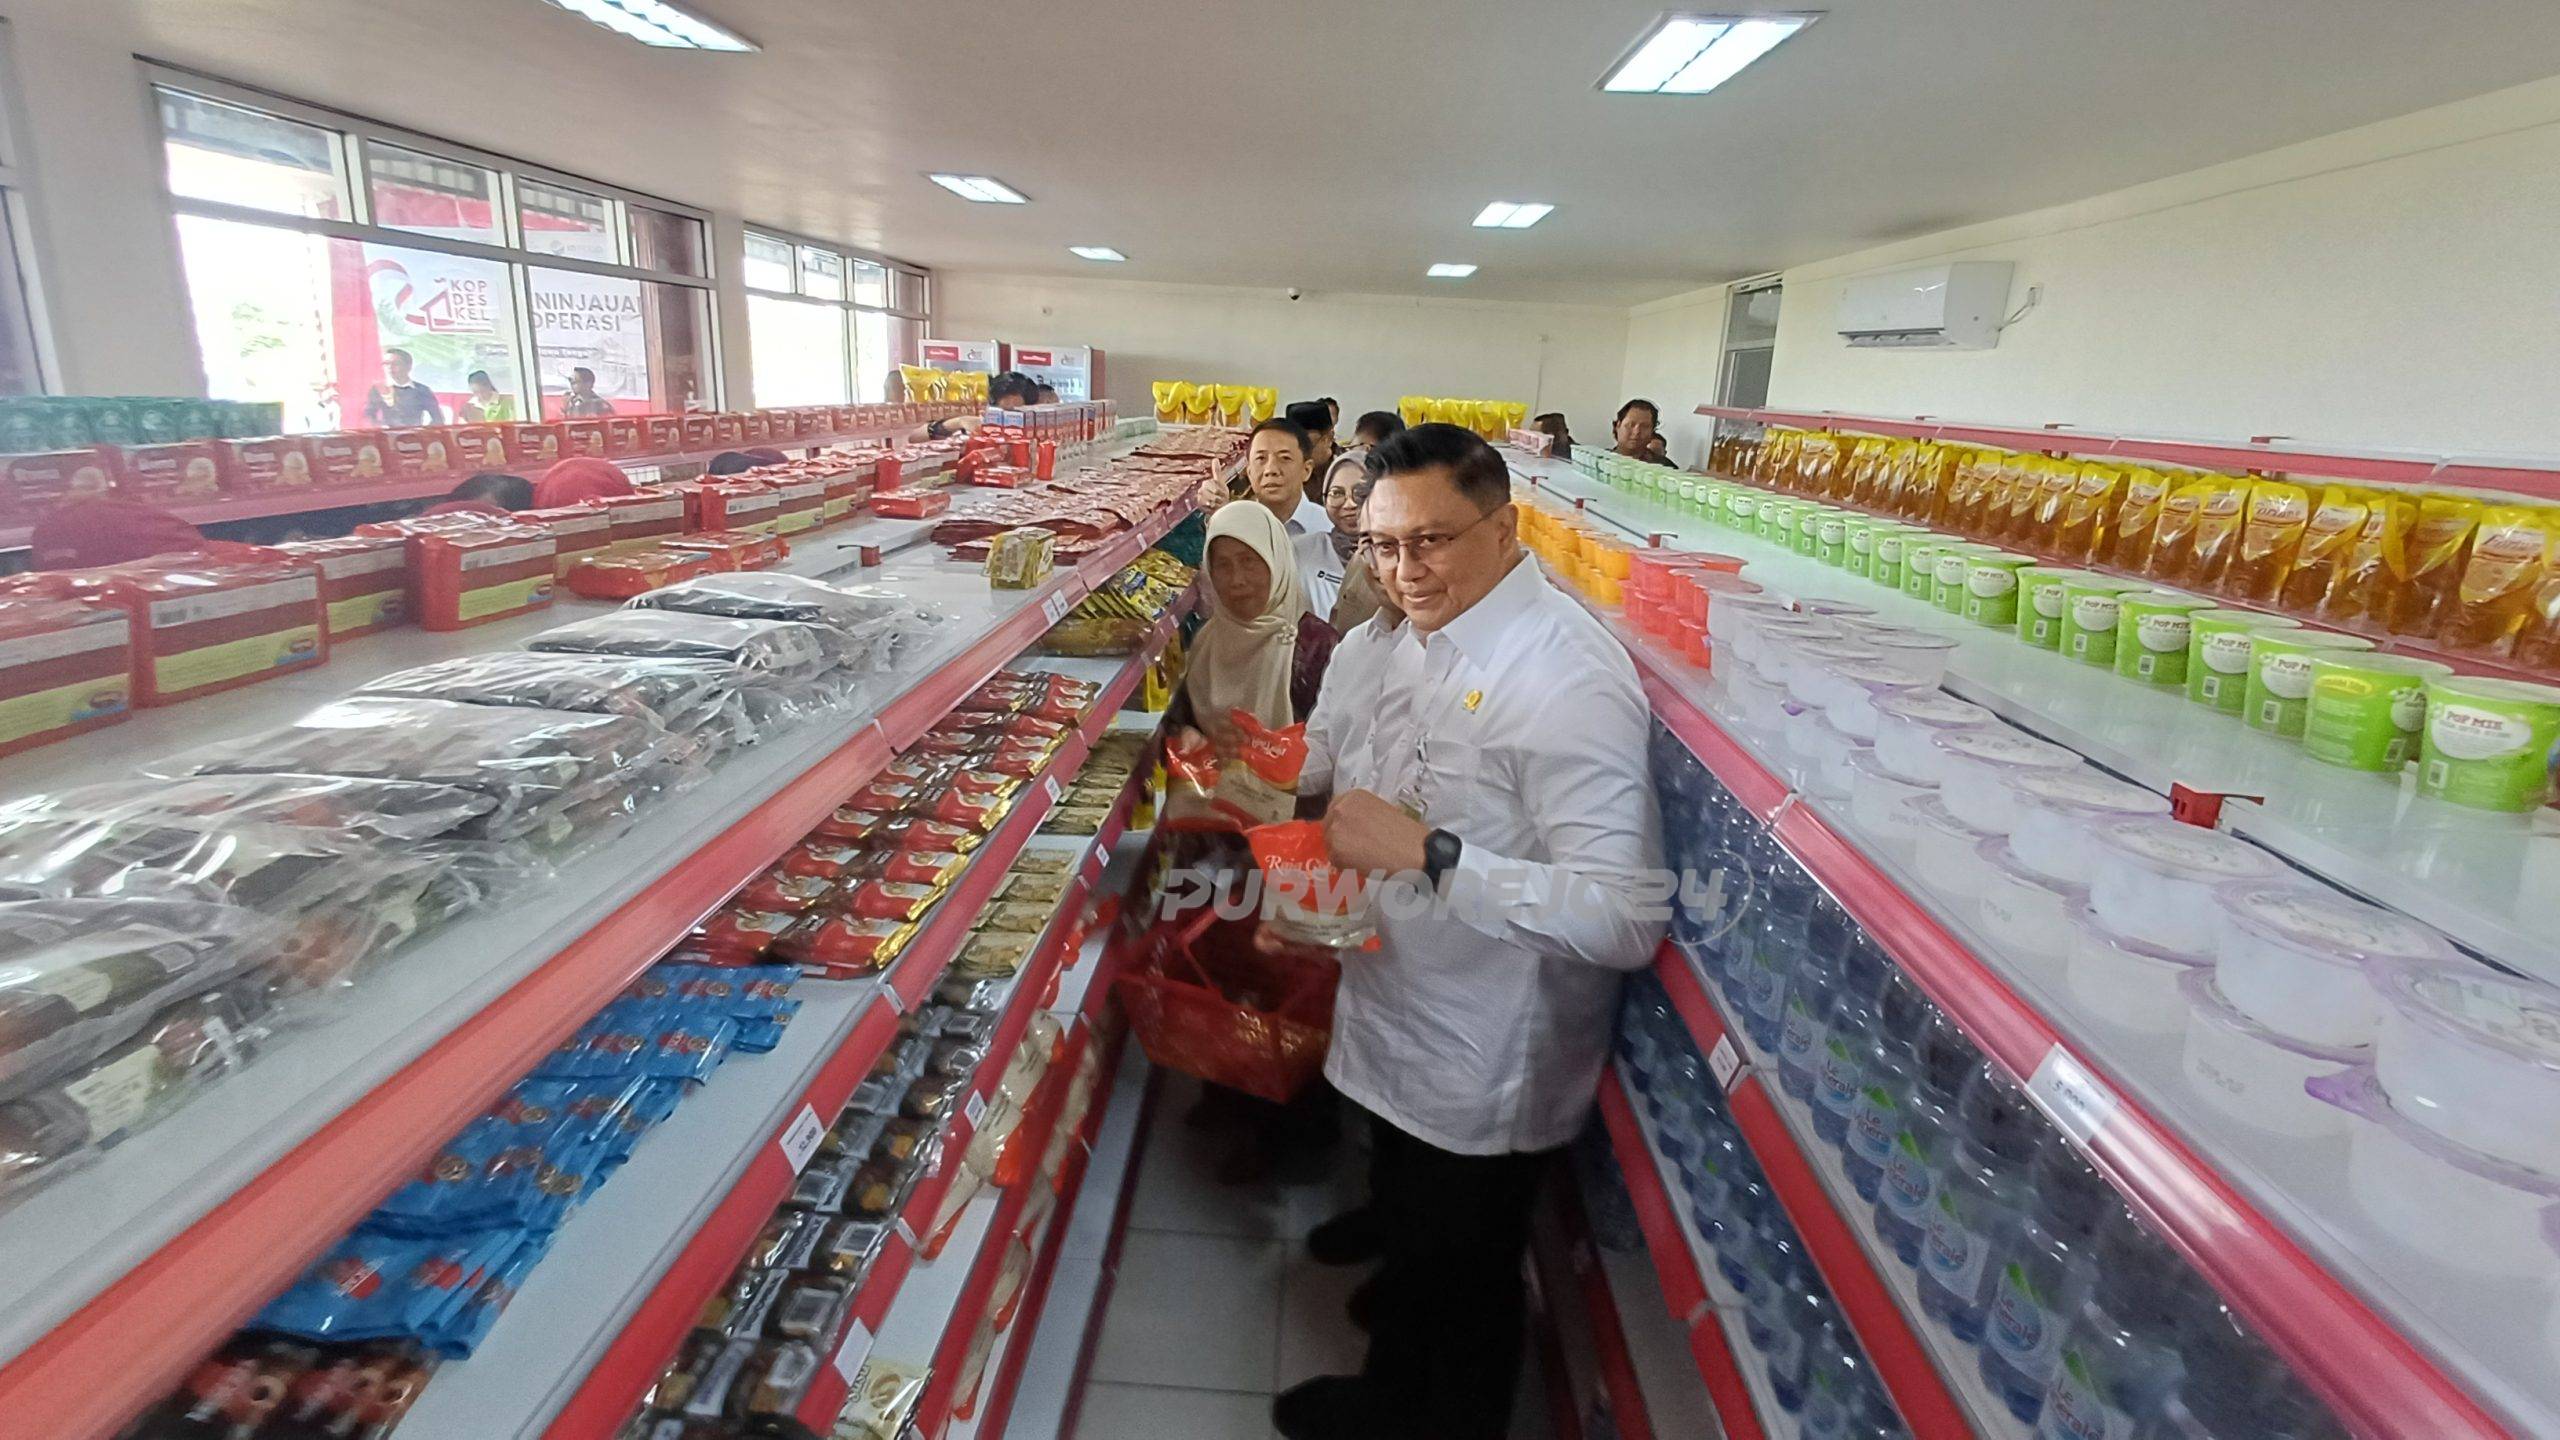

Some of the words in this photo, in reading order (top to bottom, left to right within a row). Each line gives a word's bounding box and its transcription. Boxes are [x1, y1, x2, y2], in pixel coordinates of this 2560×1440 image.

[451, 279, 487, 292] KOP
[453, 293, 487, 306] DES
[534, 291, 640, 313] NINJAUA
[455, 307, 490, 321] KEL
